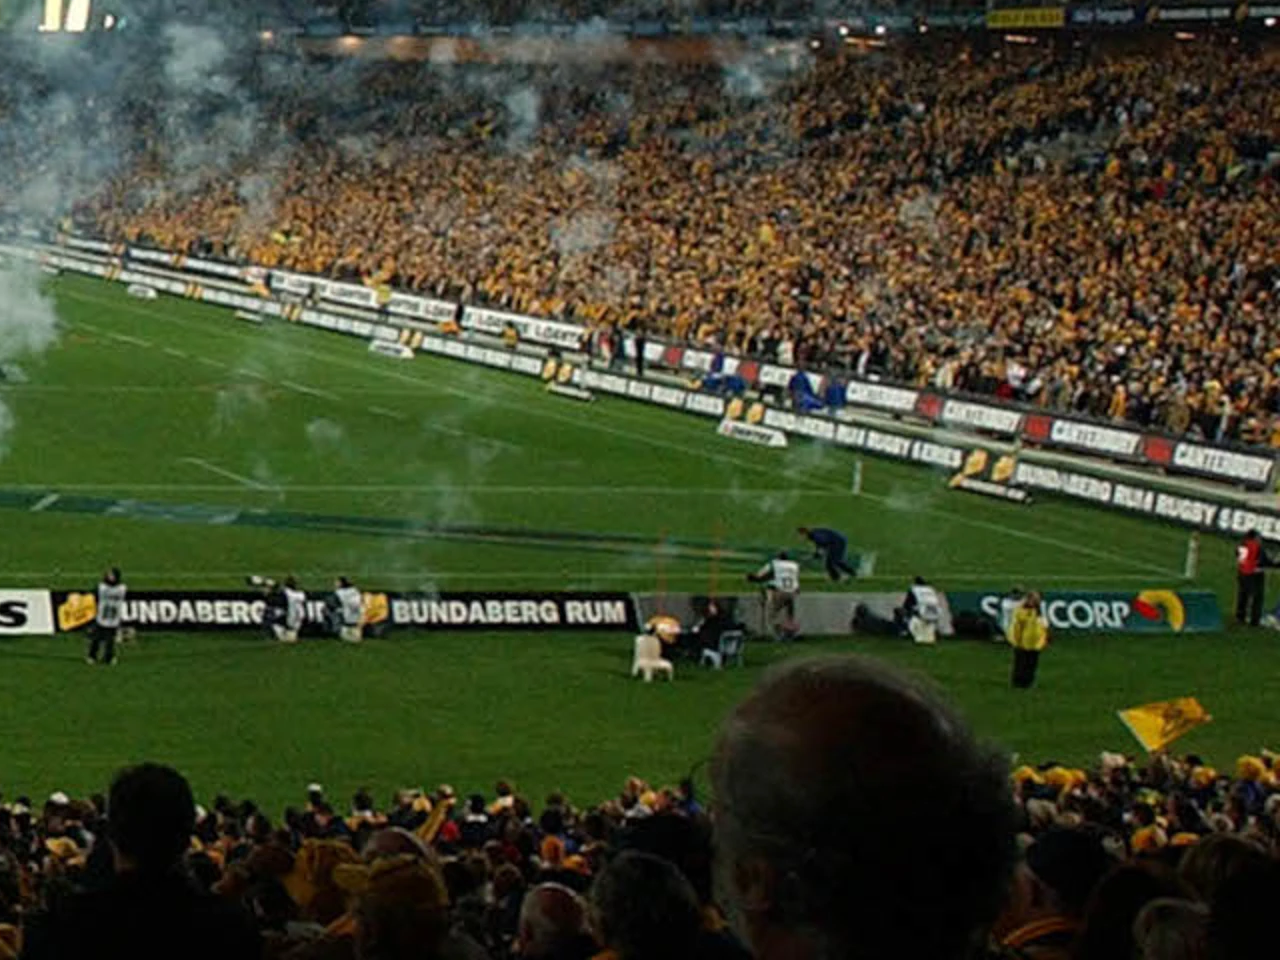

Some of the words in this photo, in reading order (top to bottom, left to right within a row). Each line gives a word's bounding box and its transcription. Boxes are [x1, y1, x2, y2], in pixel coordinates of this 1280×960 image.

[121, 599, 267, 624] UNDABERG
[393, 600, 560, 624] BUNDABERG
[565, 600, 627, 624] RUM
[981, 595, 1130, 628] SCORP
